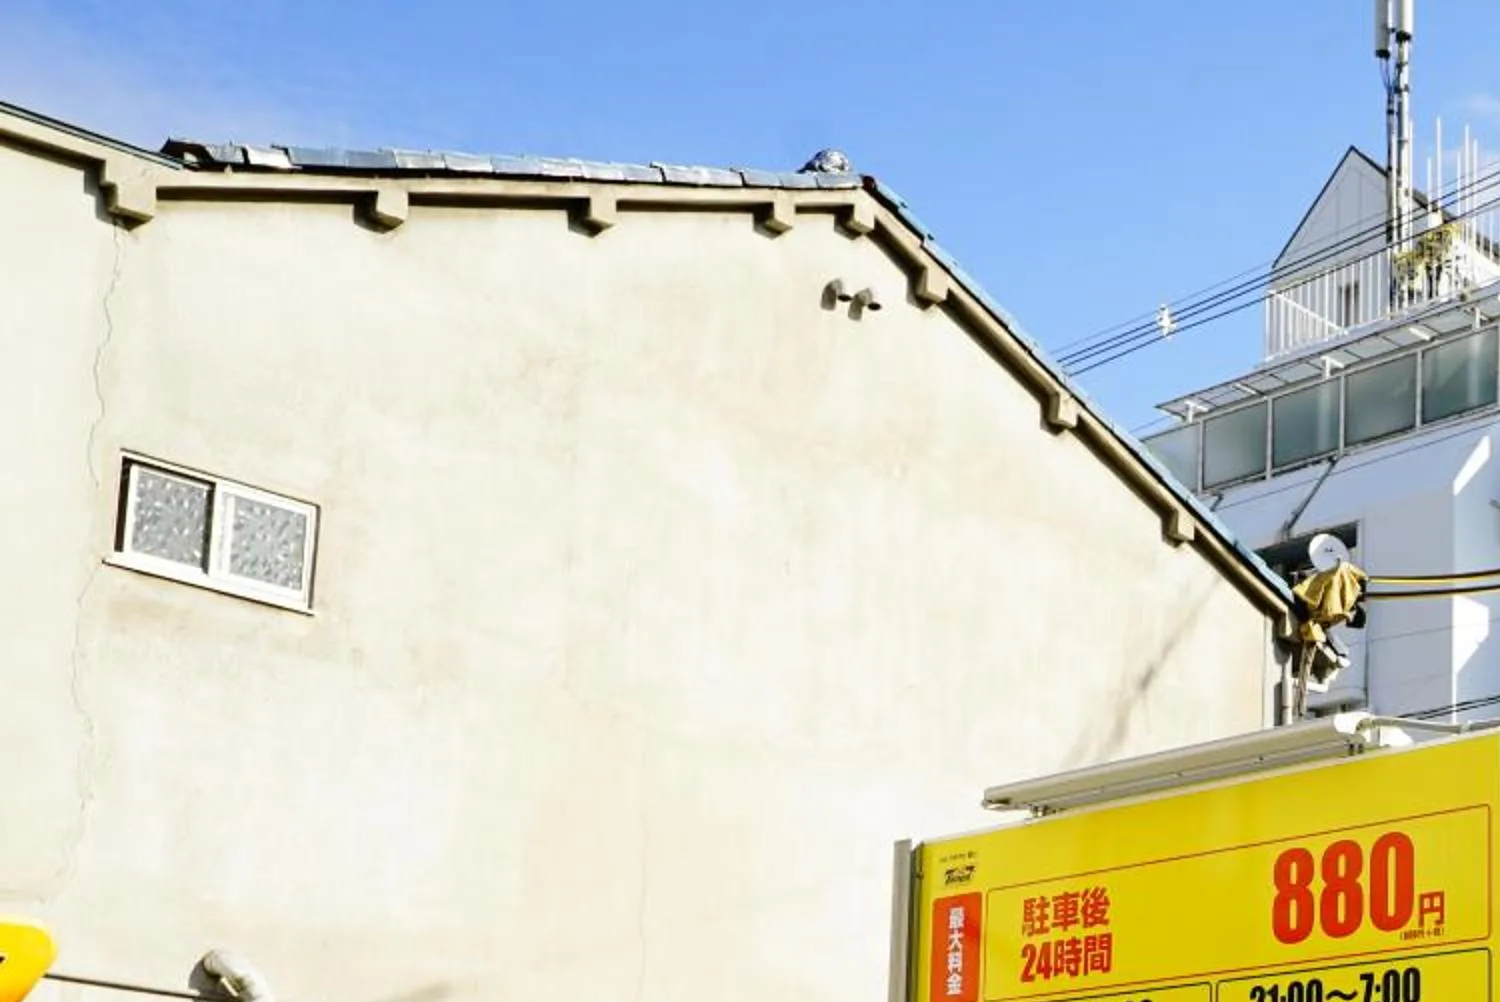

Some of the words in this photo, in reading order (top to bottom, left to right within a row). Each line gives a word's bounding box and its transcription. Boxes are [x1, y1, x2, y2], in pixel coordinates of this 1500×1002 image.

[1021, 886, 1110, 936] 駐車後
[1021, 932, 1113, 983] 24時間
